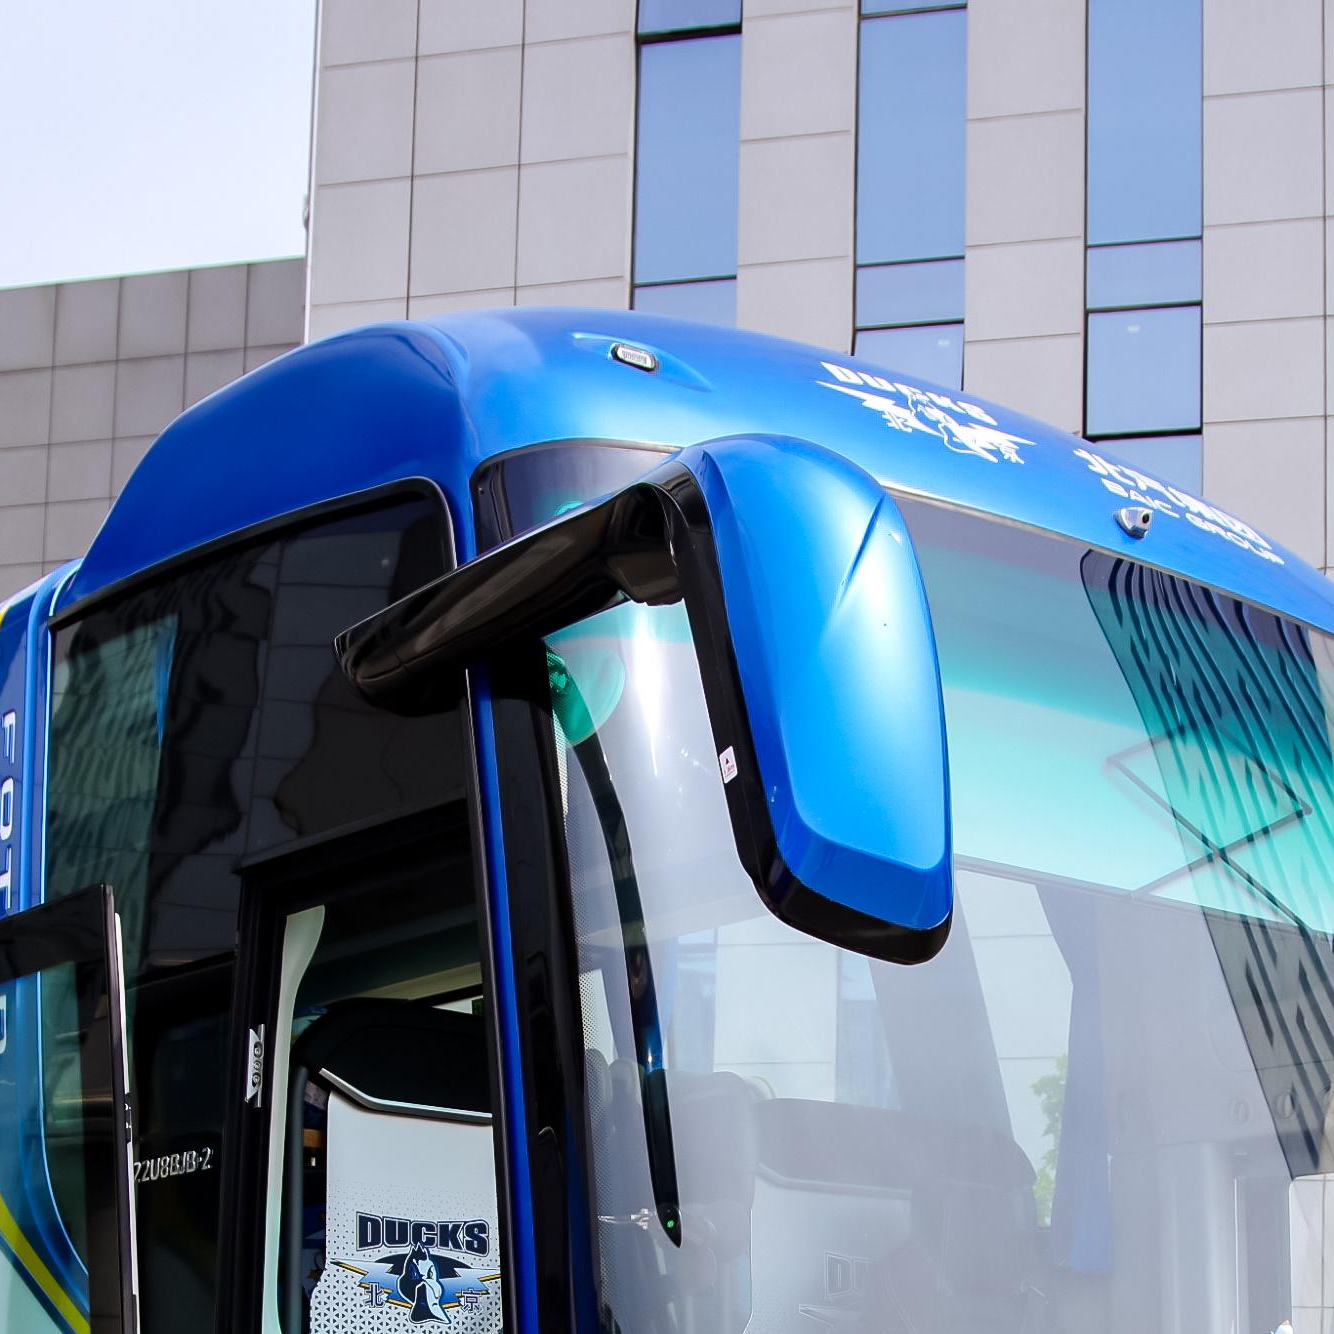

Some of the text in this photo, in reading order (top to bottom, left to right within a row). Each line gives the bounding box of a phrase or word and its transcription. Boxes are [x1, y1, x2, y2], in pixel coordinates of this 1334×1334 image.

[820, 361, 998, 426] DUCKS
[1101, 477, 1285, 565] BAIC GROUP
[356, 1211, 490, 1257] DUCKS
